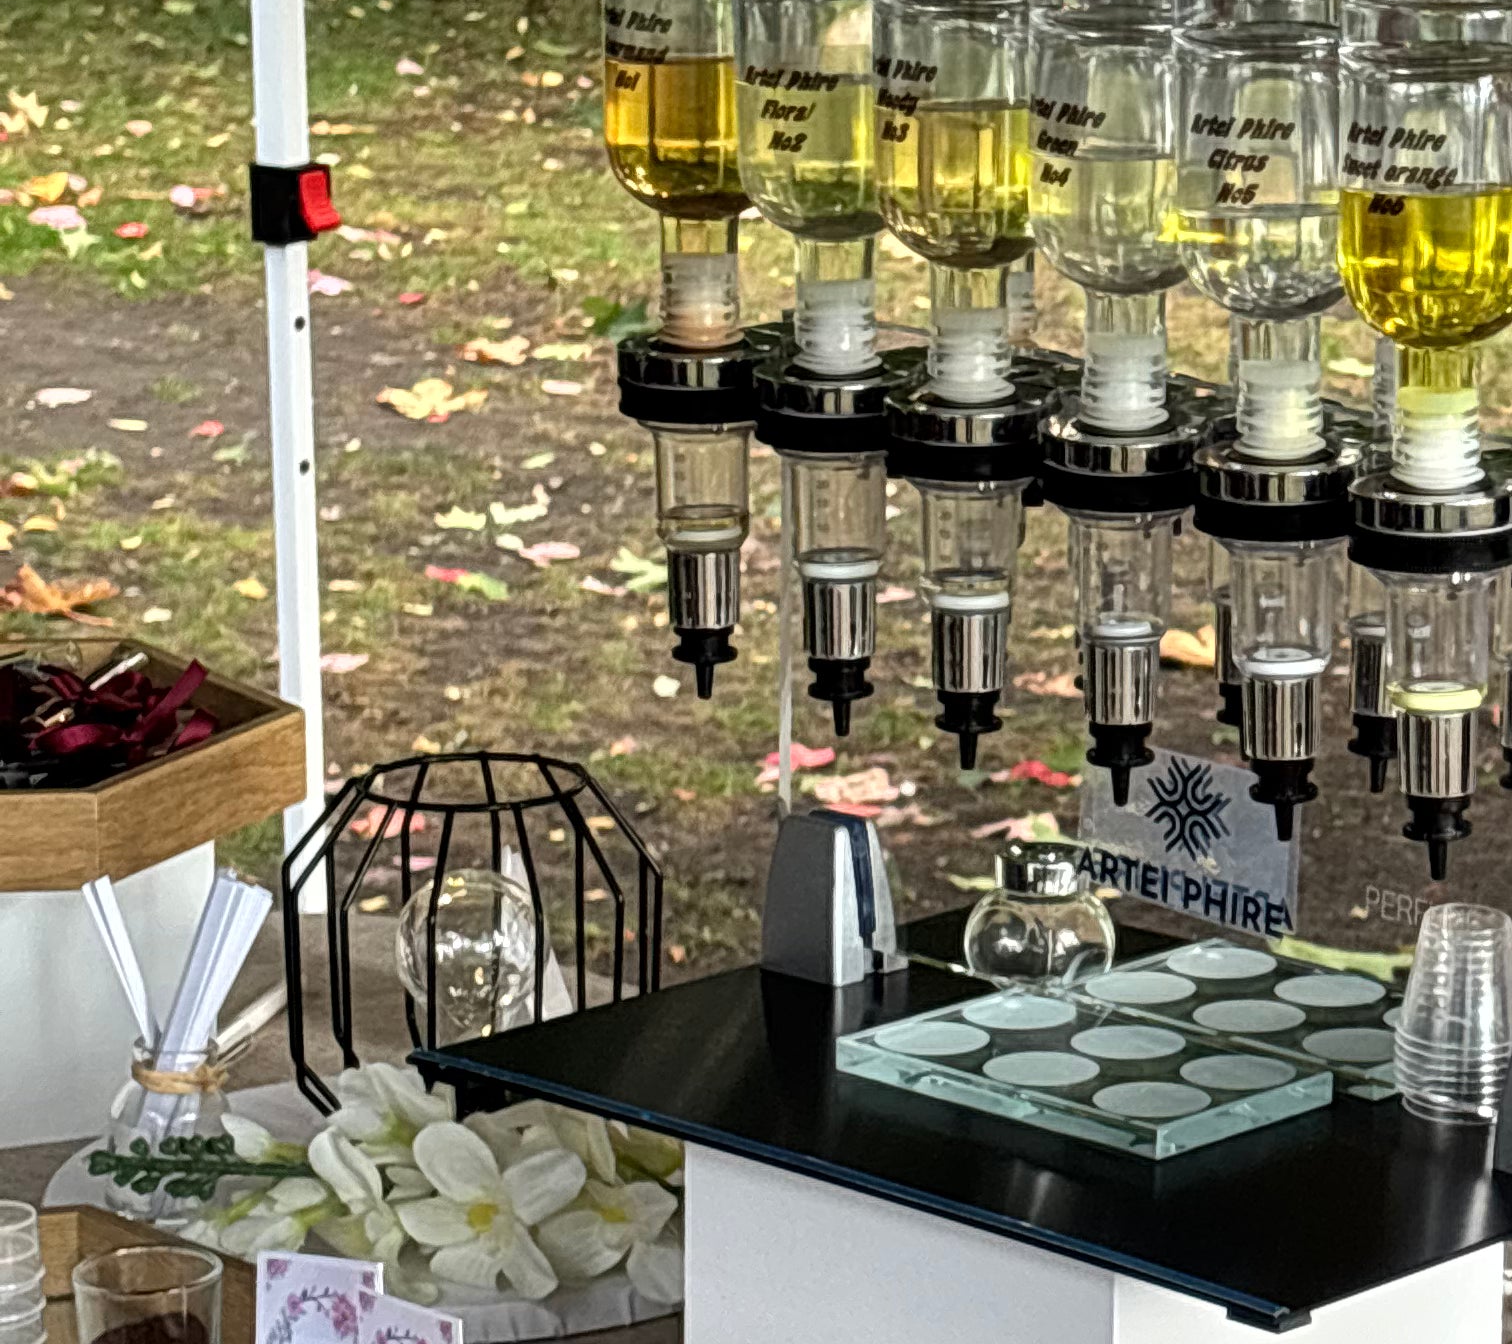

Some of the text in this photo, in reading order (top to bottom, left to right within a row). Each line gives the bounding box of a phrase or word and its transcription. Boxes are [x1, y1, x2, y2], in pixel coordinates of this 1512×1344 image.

[760, 99, 816, 121] Floral
[768, 130, 808, 152] No2
[1207, 148, 1269, 172] Citrus
[1183, 876, 1285, 940] PHIRE
